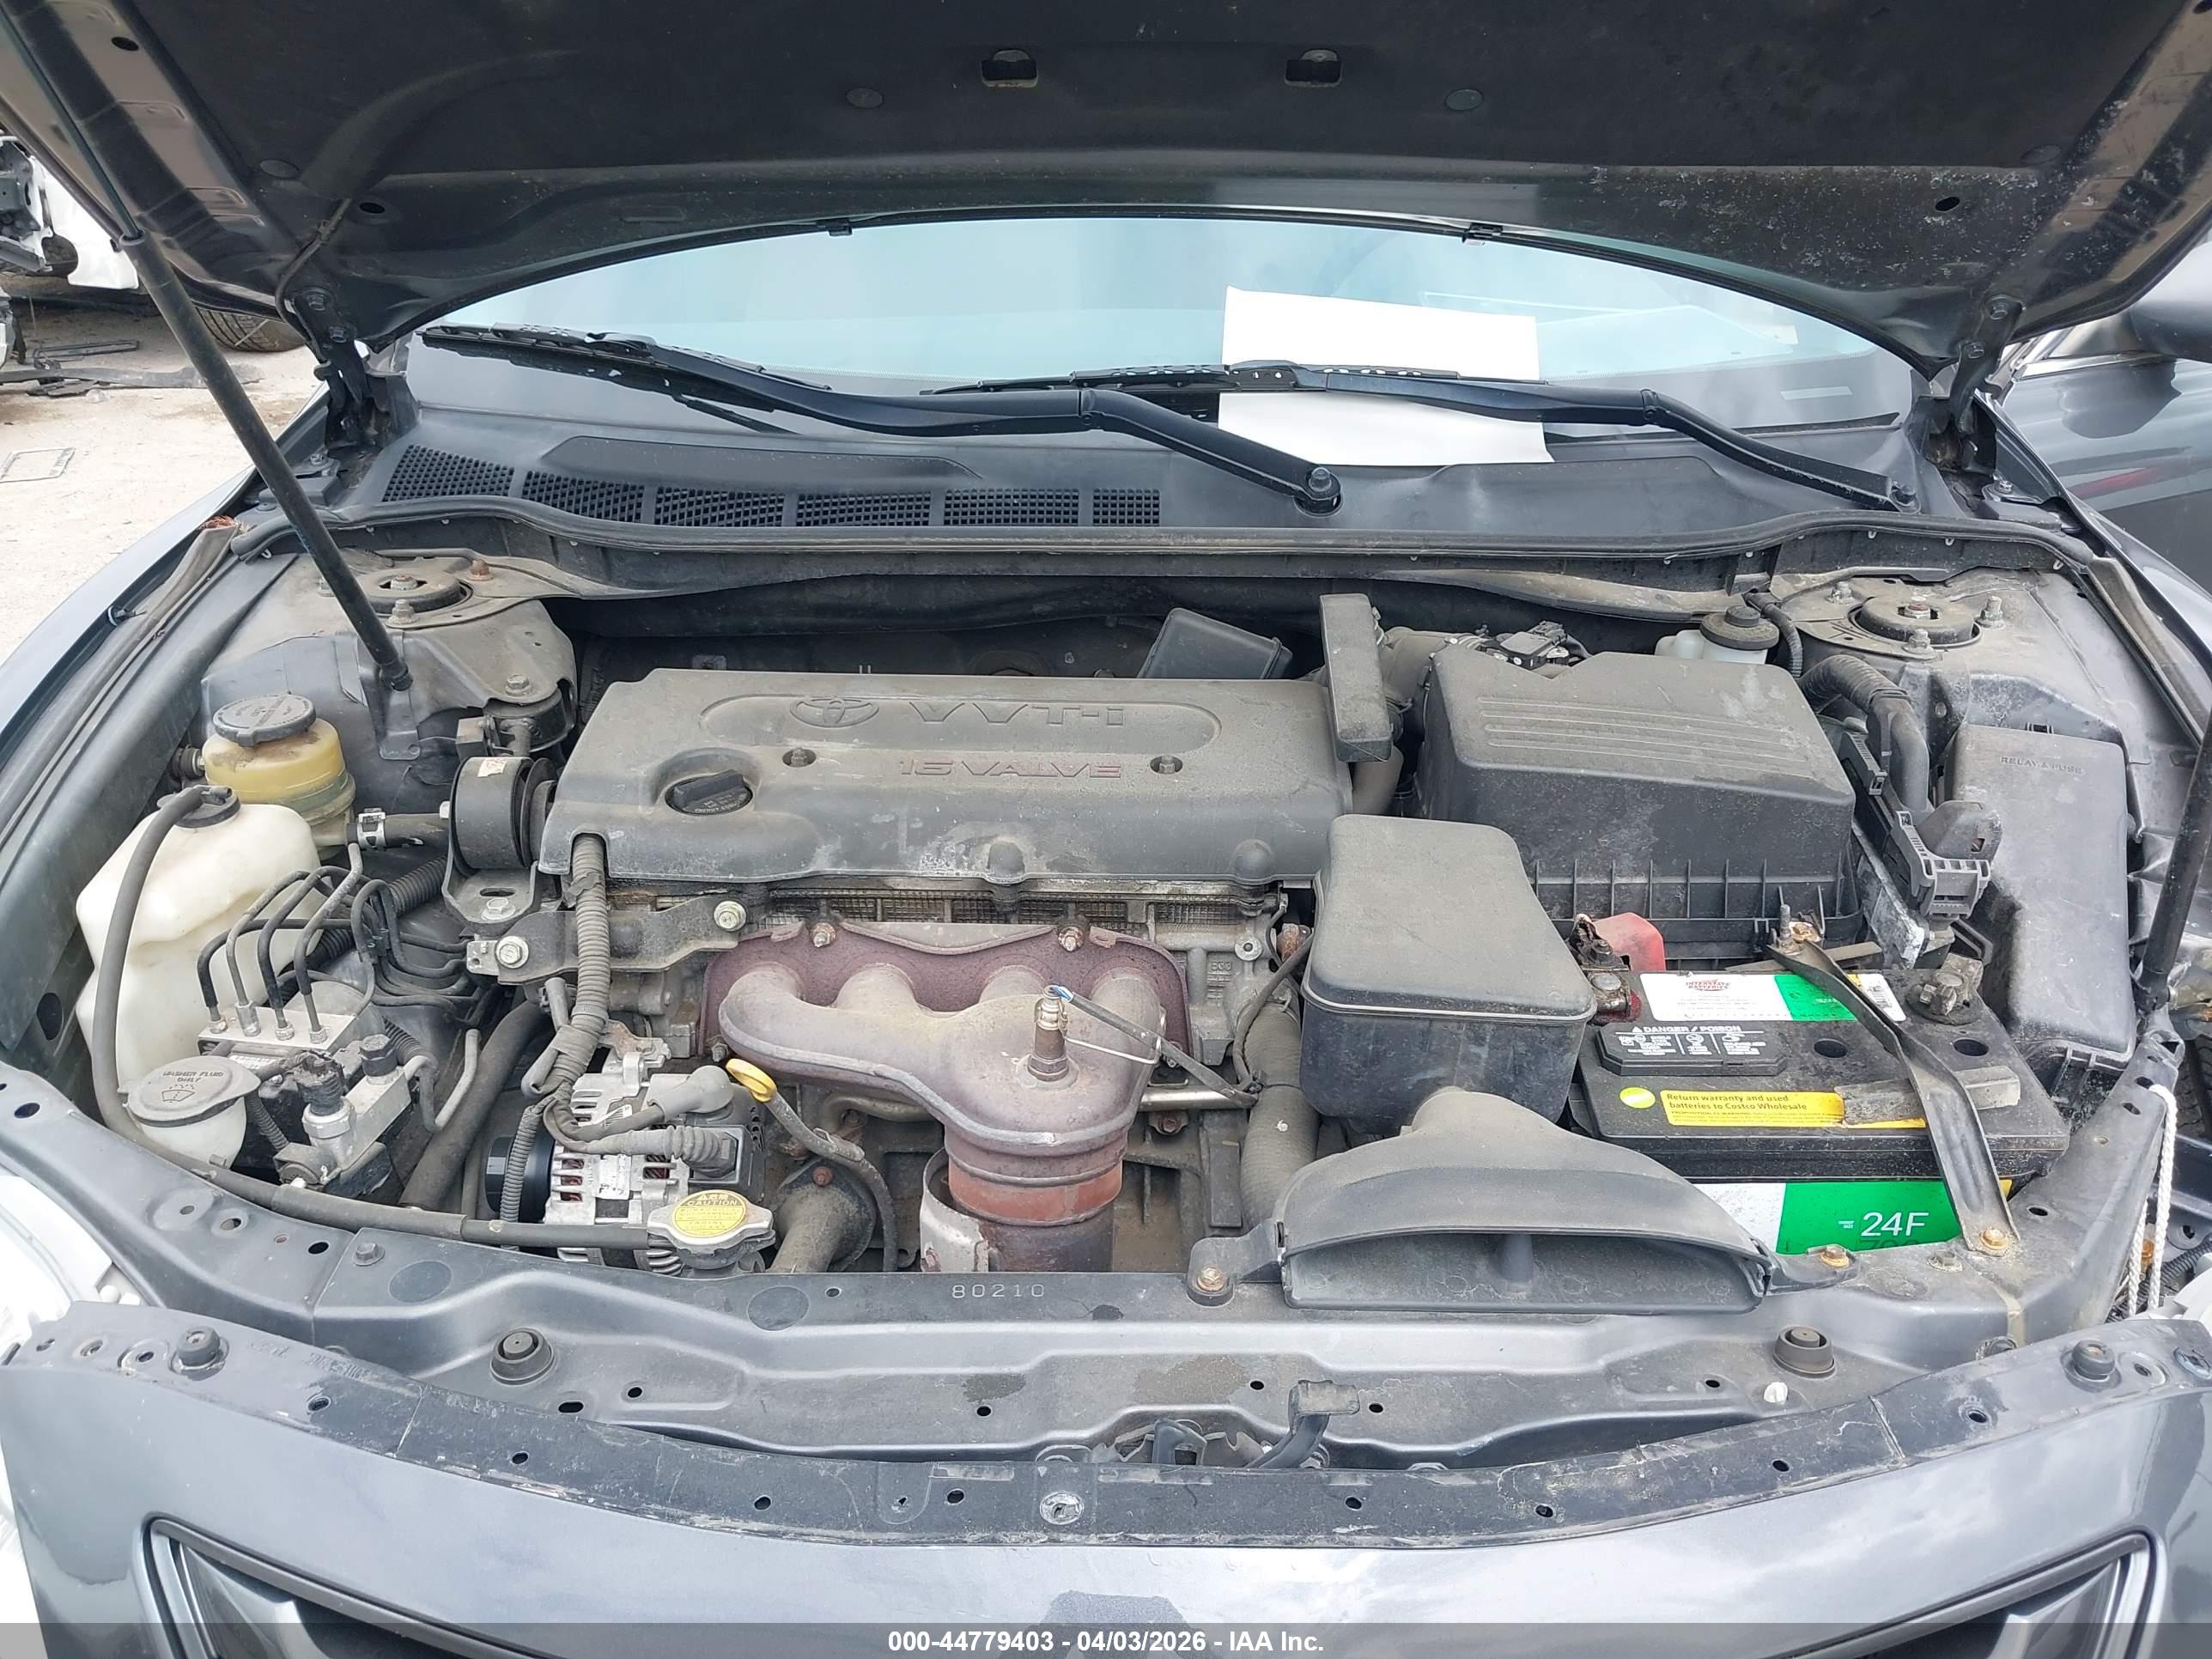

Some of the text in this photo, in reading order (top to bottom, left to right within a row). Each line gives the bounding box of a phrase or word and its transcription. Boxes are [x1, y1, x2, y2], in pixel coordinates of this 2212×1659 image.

[2001, 756, 2039, 767] RELAY
[1861, 1212, 1929, 1237] 24F
[951, 1284, 1045, 1298] 80210
